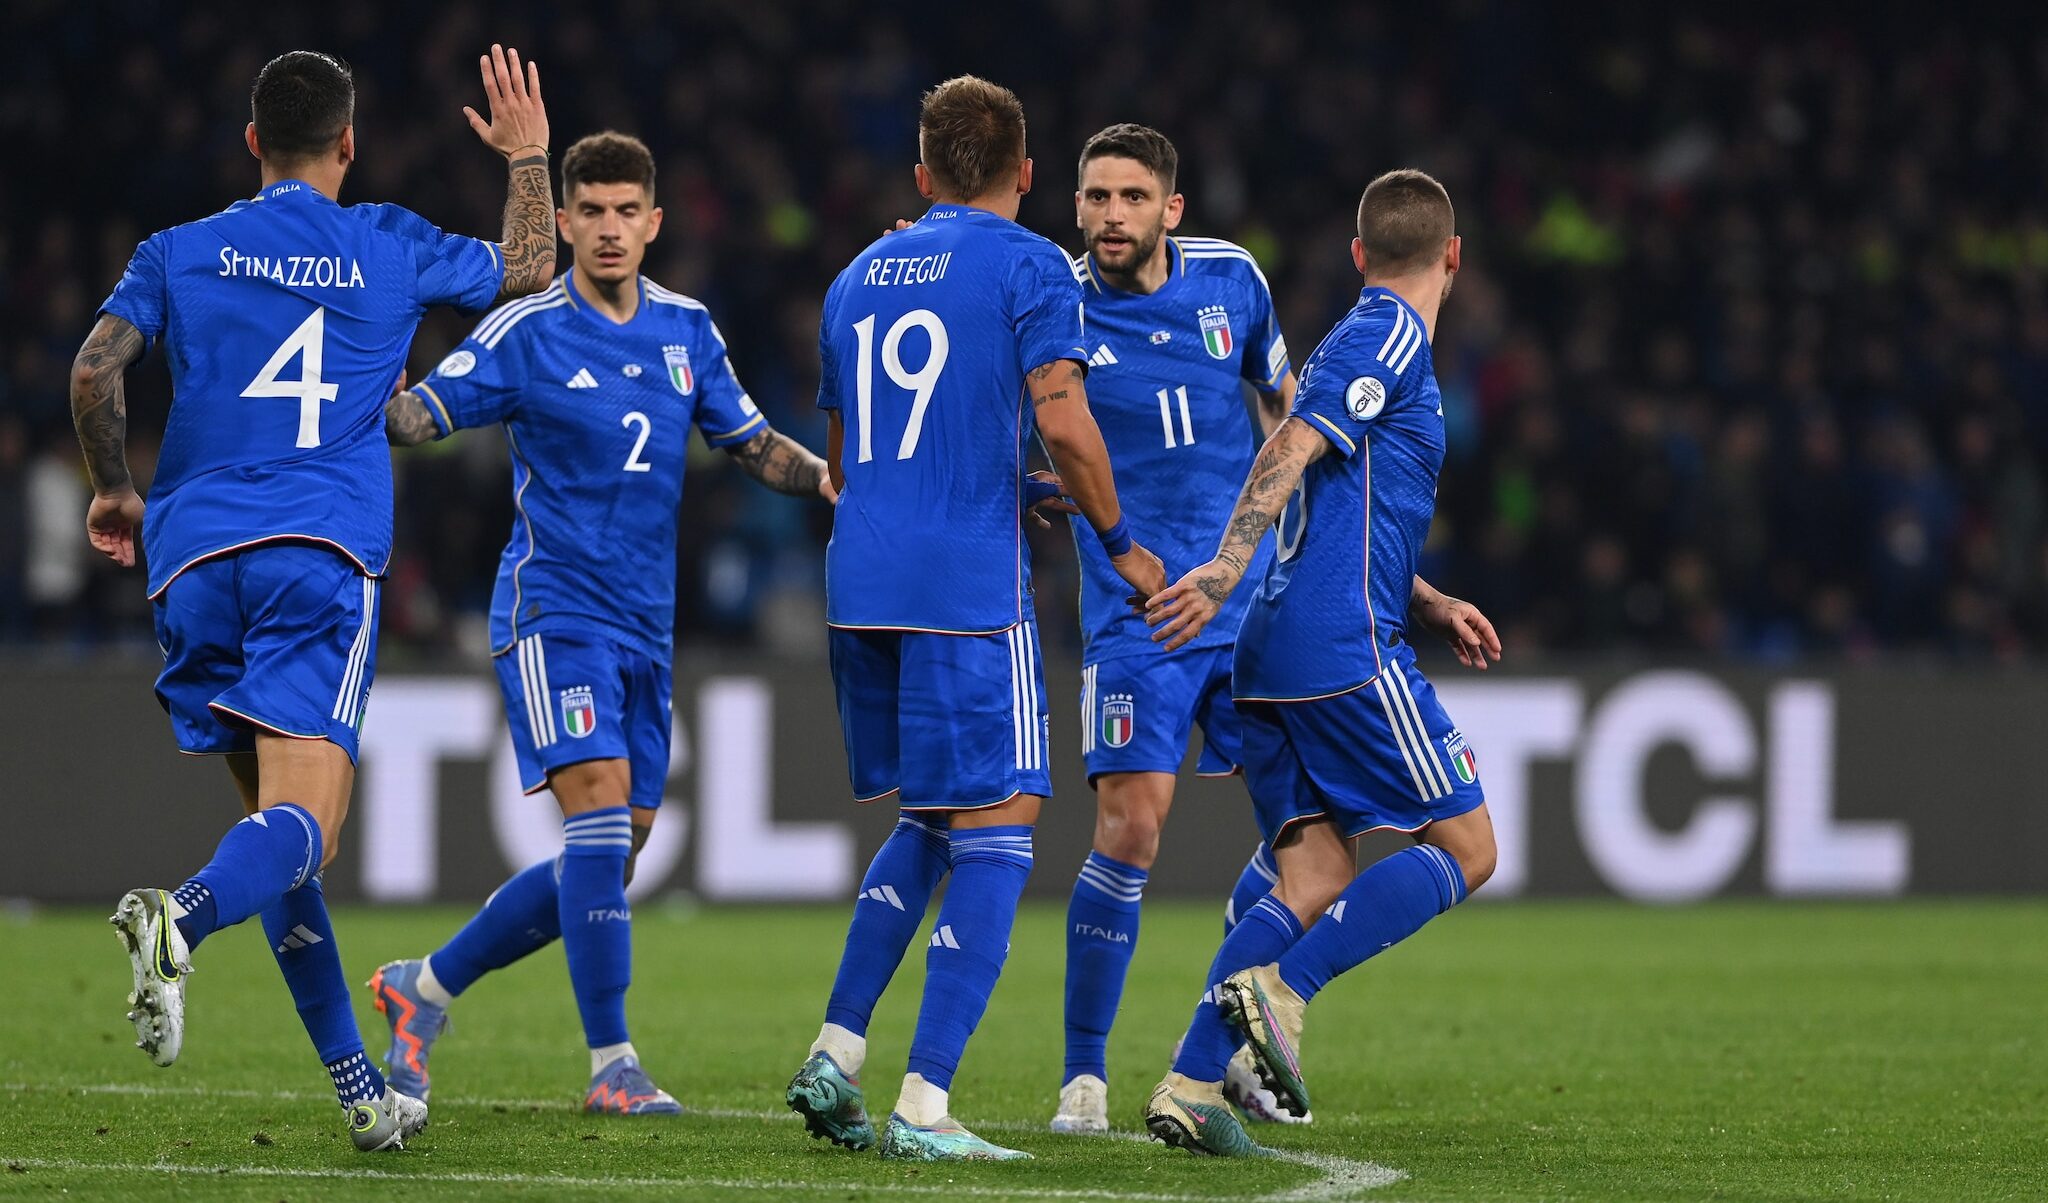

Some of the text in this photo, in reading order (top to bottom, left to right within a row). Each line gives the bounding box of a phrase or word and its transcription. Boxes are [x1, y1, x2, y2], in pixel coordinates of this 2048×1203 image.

[271, 183, 301, 198] ITALIA
[930, 210, 958, 221] ITALIA
[218, 246, 366, 288] SPINAZZOLA
[863, 251, 952, 286] RETEGUI
[1202, 314, 1227, 329] ITALIA
[239, 305, 340, 449] 4
[852, 308, 950, 464] 19
[1156, 384, 1196, 450] 11
[621, 411, 652, 473] 2
[1104, 704, 1130, 715] ITALIA
[1447, 737, 1467, 758] ITALIA
[1432, 671, 1910, 901] TCL
[1075, 922, 1129, 944] ITALIA
